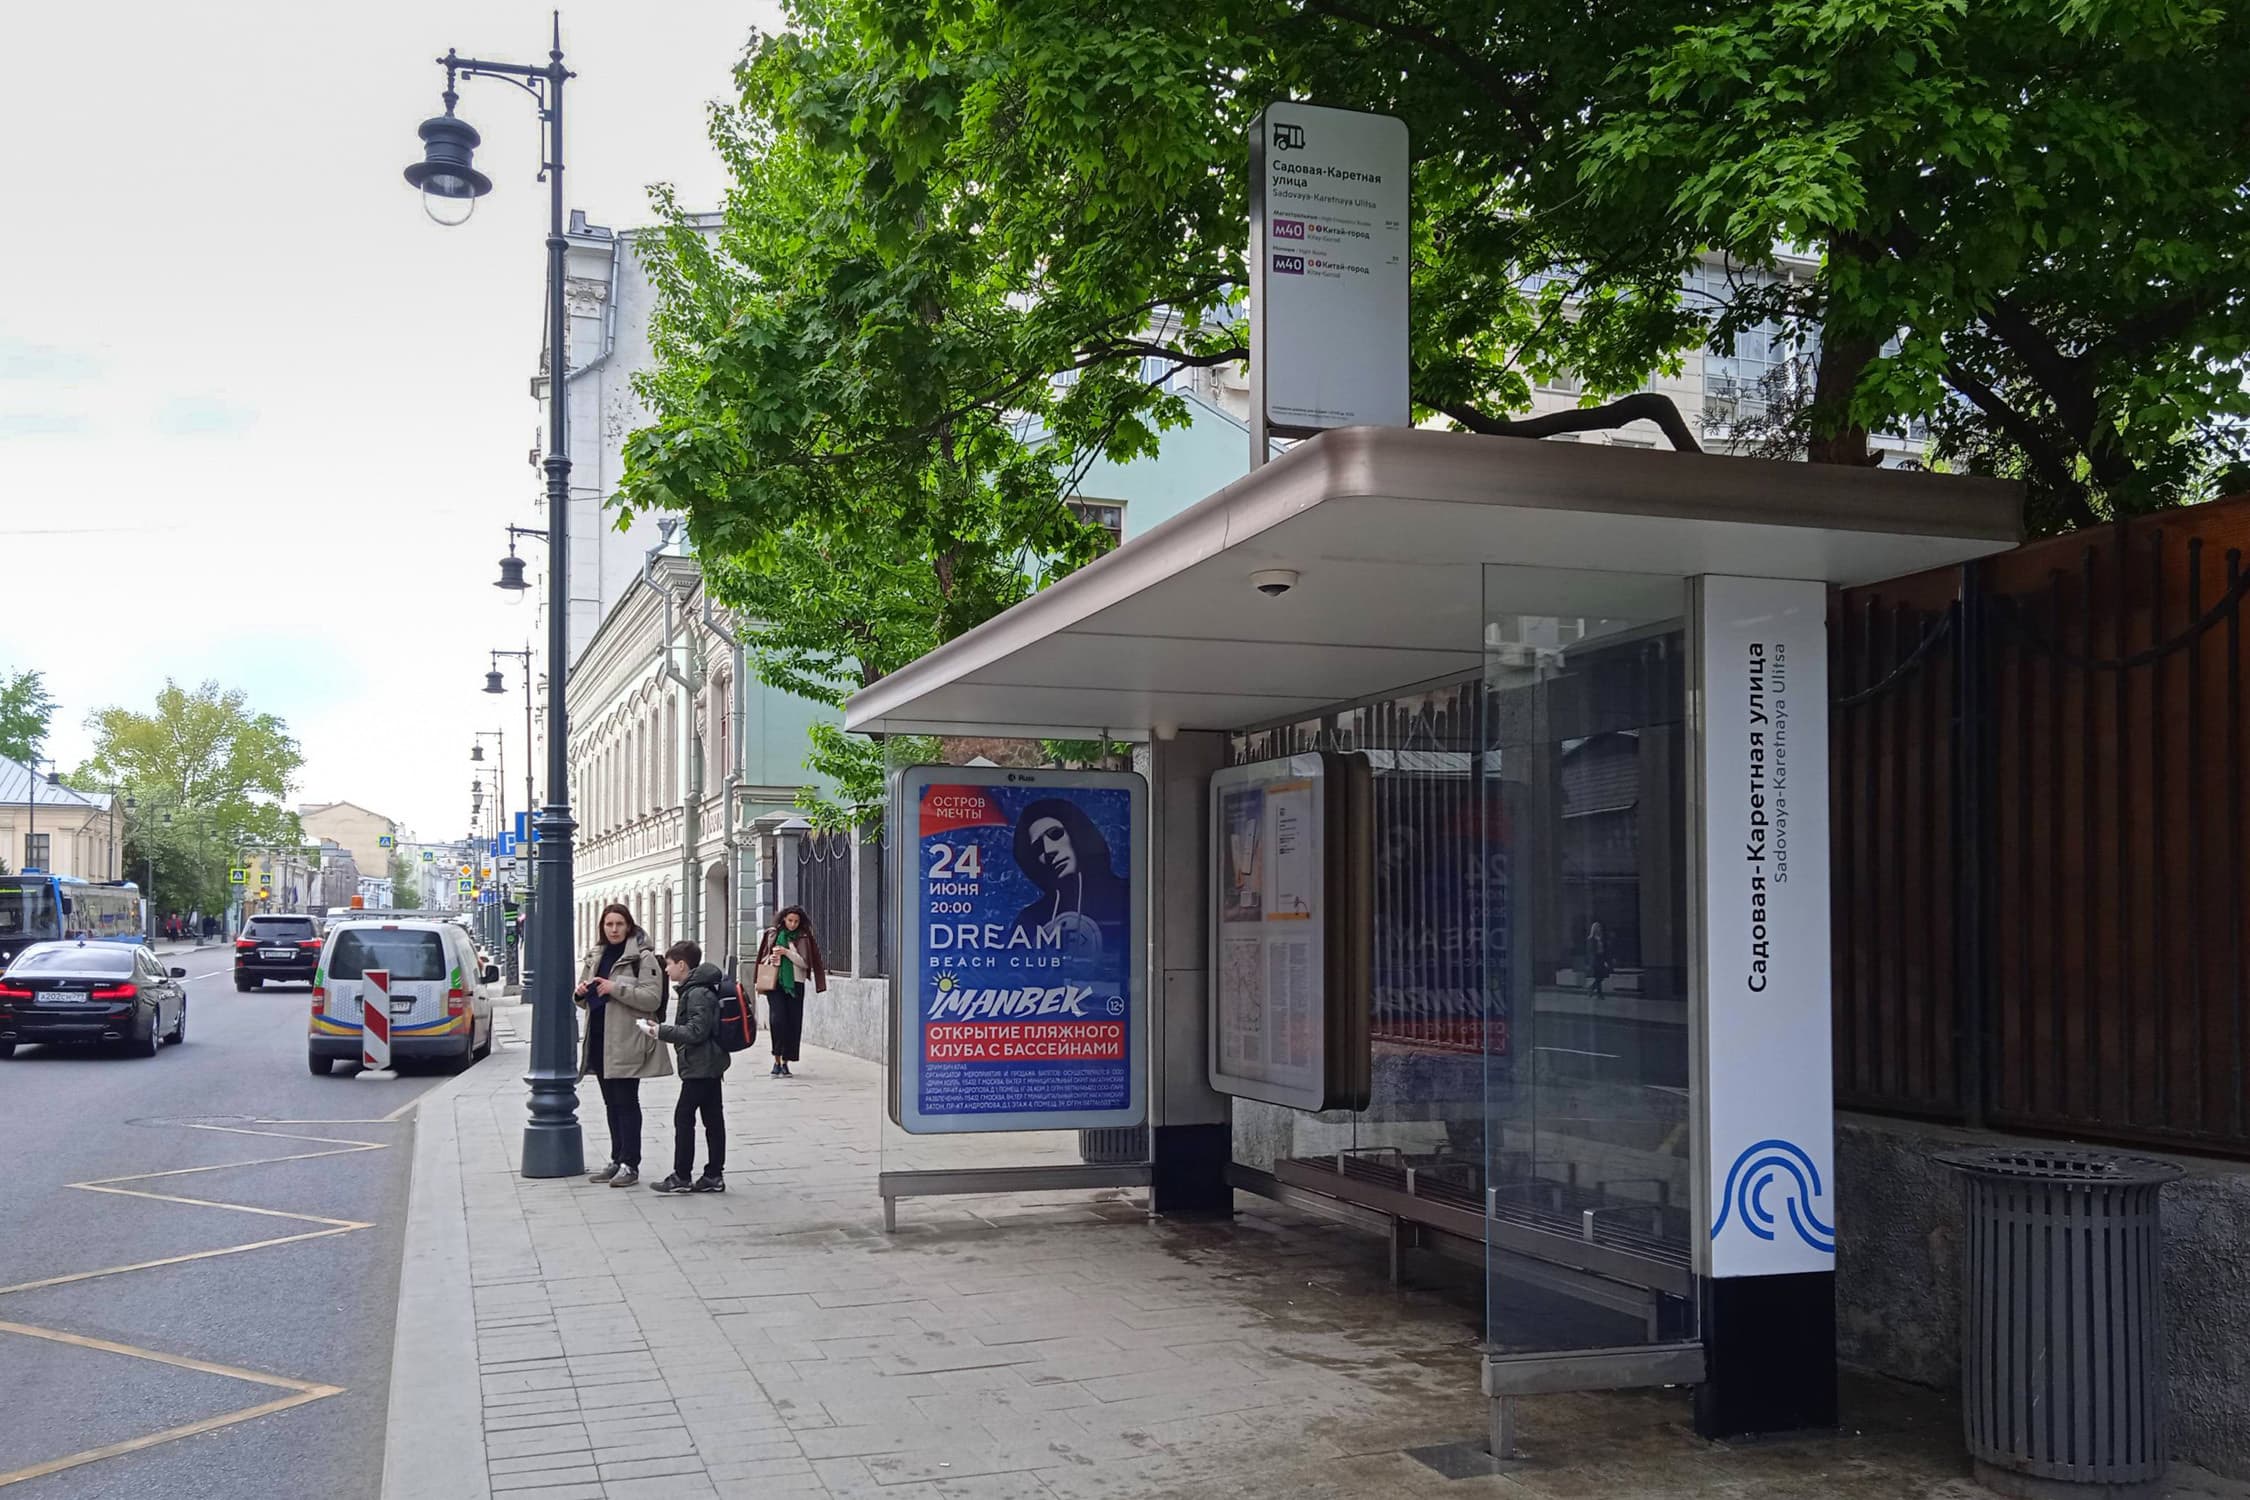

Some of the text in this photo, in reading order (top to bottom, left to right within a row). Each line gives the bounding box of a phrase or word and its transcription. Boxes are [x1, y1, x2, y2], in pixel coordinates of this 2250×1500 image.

[1272, 160, 1382, 184] Садовая-Каретная
[1272, 175, 1308, 188] улица
[1354, 199, 1377, 209] Ulitsa
[1322, 226, 1371, 240] Китай-город
[1321, 261, 1370, 275] Китай-город
[1772, 643, 1789, 883] Sadovaya-Karetnaya Ulitsa
[933, 796, 986, 808] ОСТРОВ
[936, 807, 983, 819] МЕЧТЫ
[1746, 642, 1769, 993] Садовая-Каретная улица
[928, 843, 981, 879] 24
[929, 882, 979, 896] ИЮНЯ
[930, 902, 972, 914] 20:00
[930, 923, 1062, 950] DREAM
[930, 956, 996, 968] BEACH
[930, 1024, 1121, 1041] ОТКРЫТИЕ ПЛЯЖНОГО
[930, 1039, 1119, 1058] КЛУБА С БАССЕЙНАМИ
